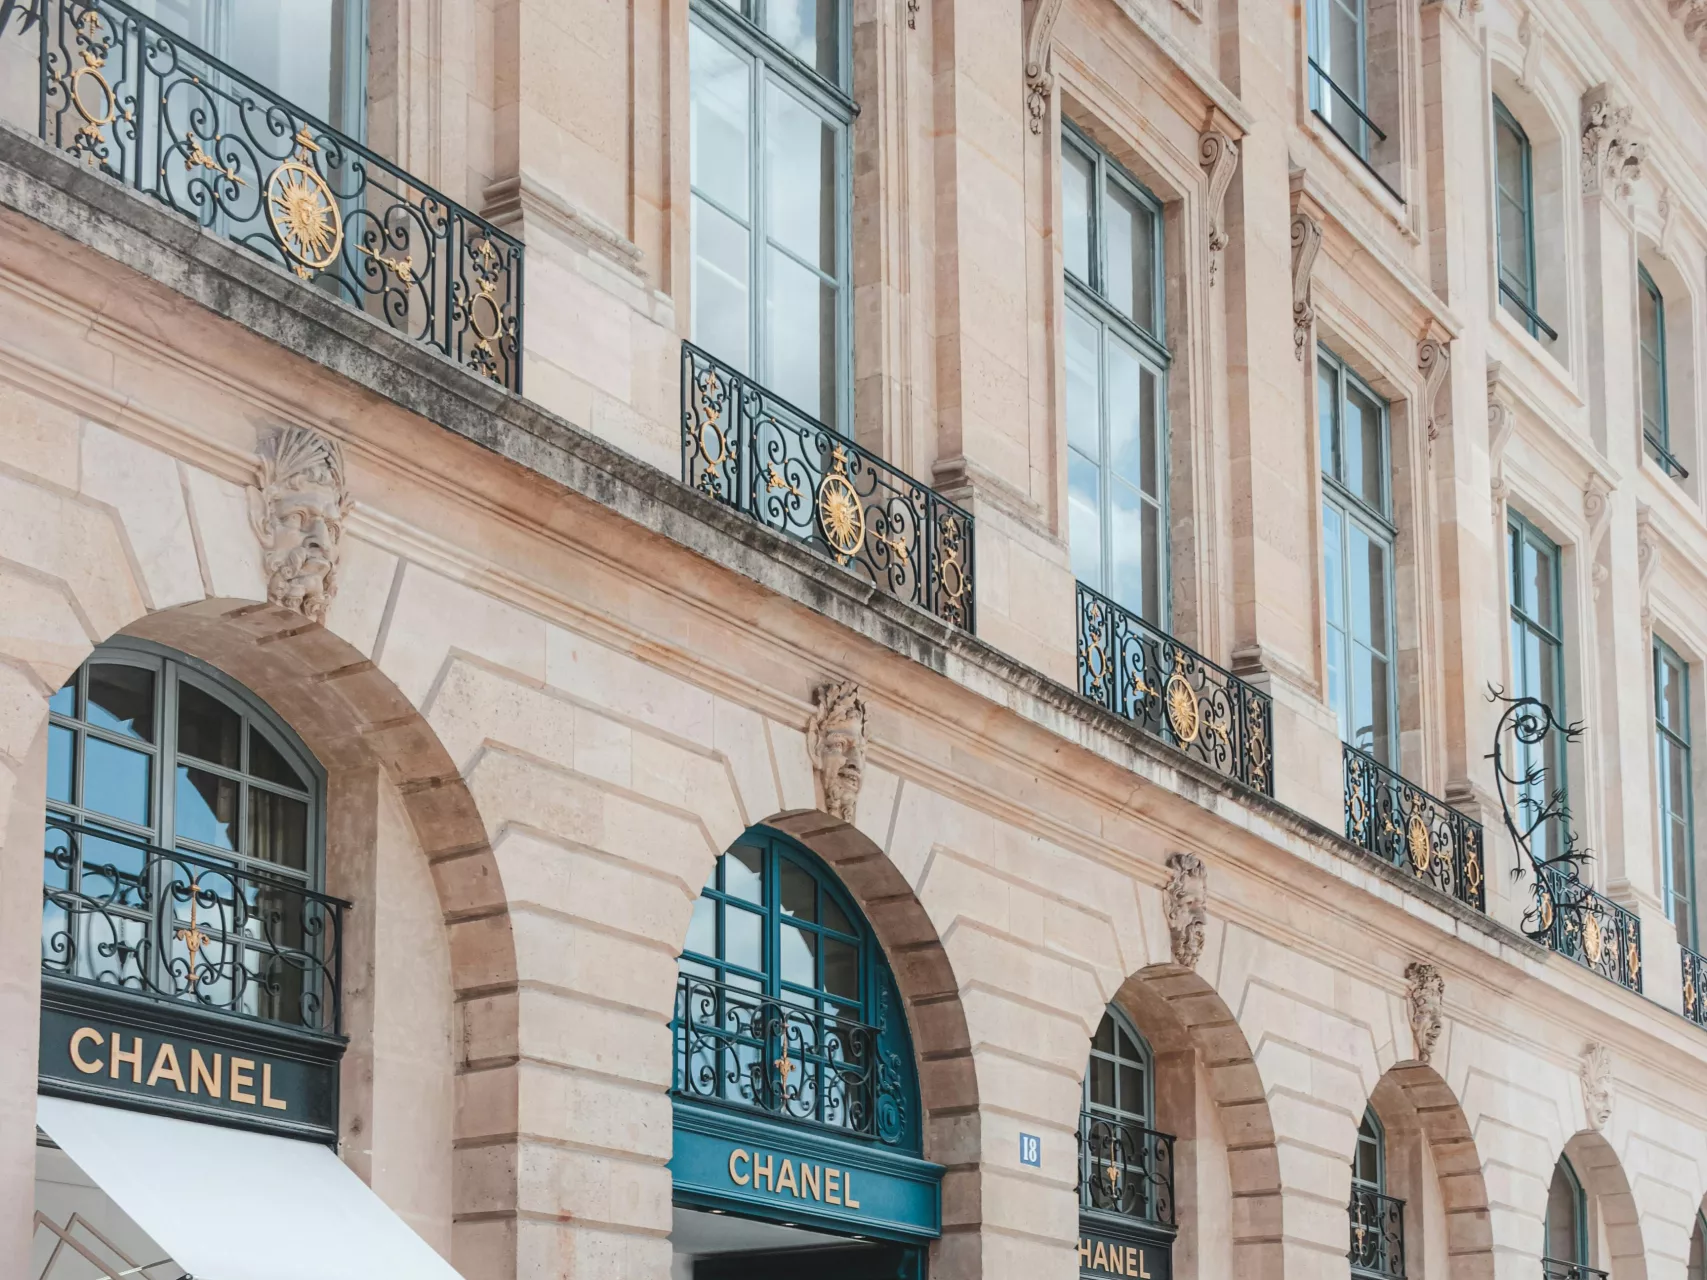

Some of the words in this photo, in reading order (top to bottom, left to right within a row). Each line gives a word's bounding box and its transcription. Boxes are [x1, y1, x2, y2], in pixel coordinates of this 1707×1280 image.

[69, 1026, 287, 1110] CHANEL
[1023, 1136, 1037, 1163] 18
[728, 1148, 860, 1209] CHANEL
[1078, 1237, 1151, 1280] HANEL
